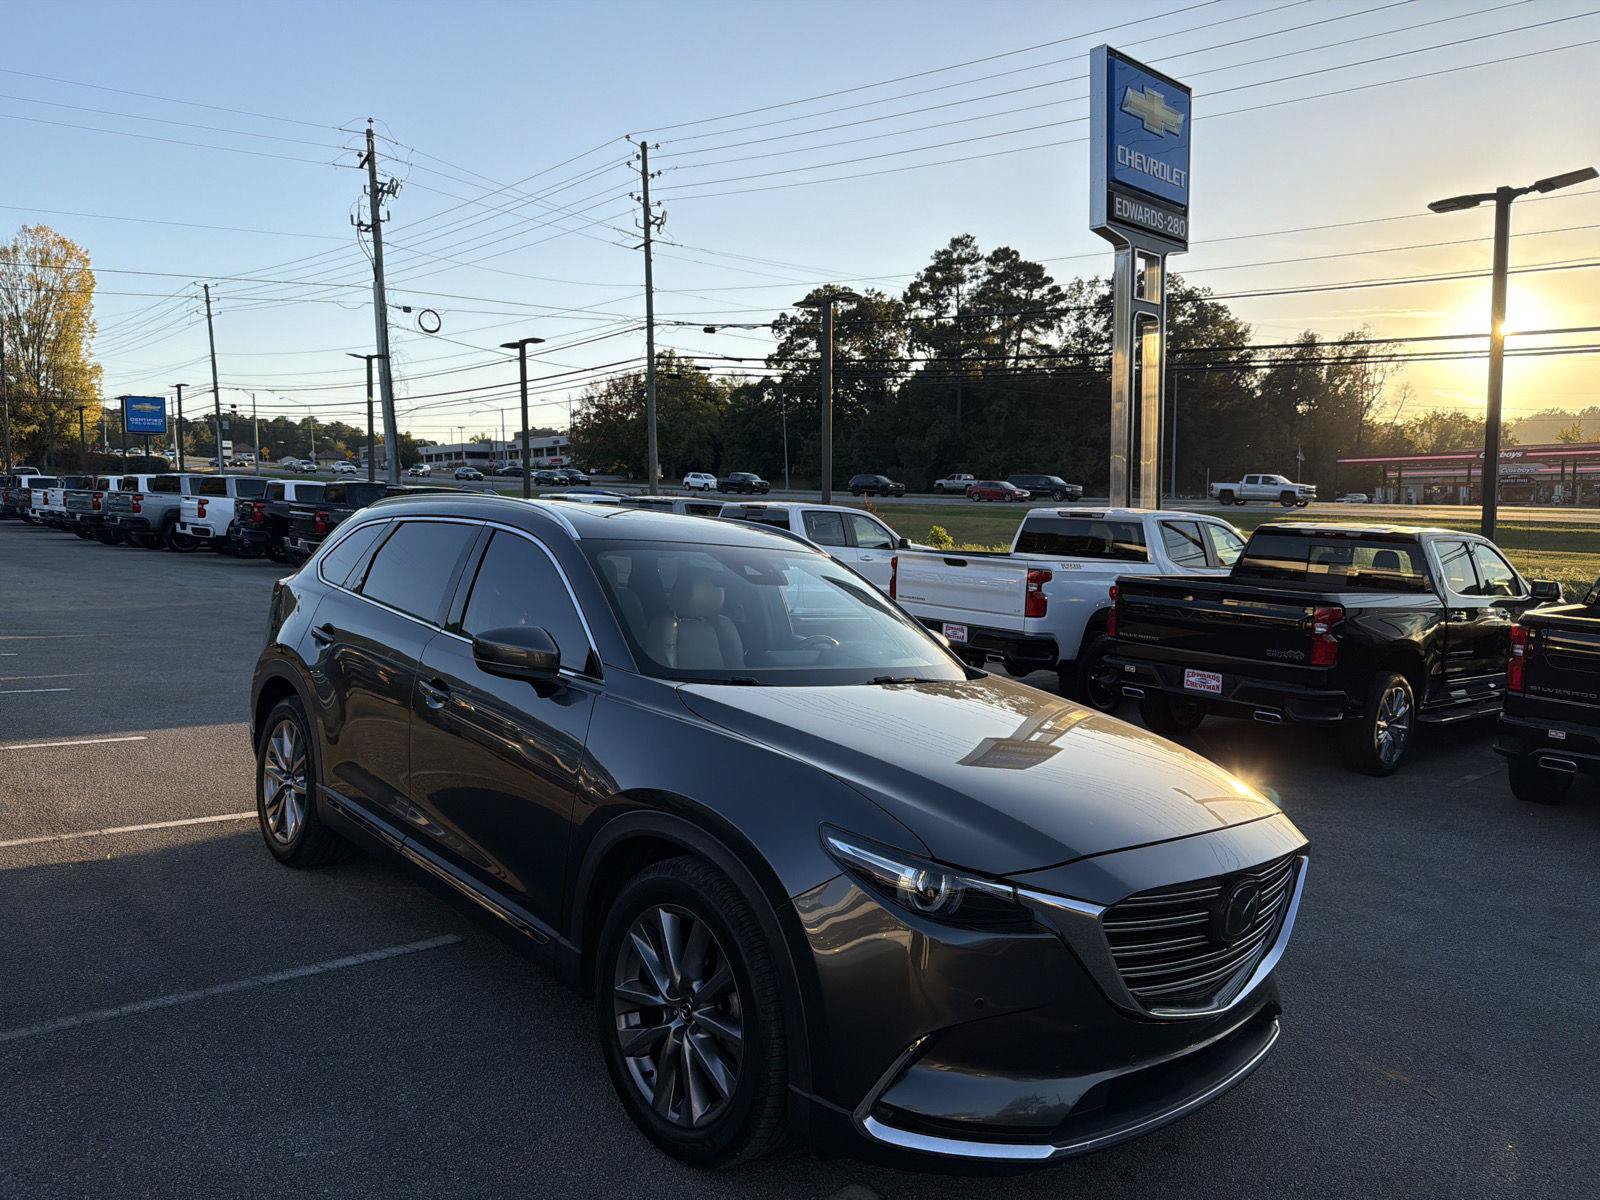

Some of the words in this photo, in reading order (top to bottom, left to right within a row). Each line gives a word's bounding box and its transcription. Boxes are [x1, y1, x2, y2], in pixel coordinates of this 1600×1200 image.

[1117, 145, 1186, 188] CHEVROLET
[1115, 197, 1186, 237] EDWARDS-280
[1479, 450, 1523, 459] Cboys
[1187, 671, 1221, 683] EDWARDS
[1530, 685, 1598, 700] SILVERADO
